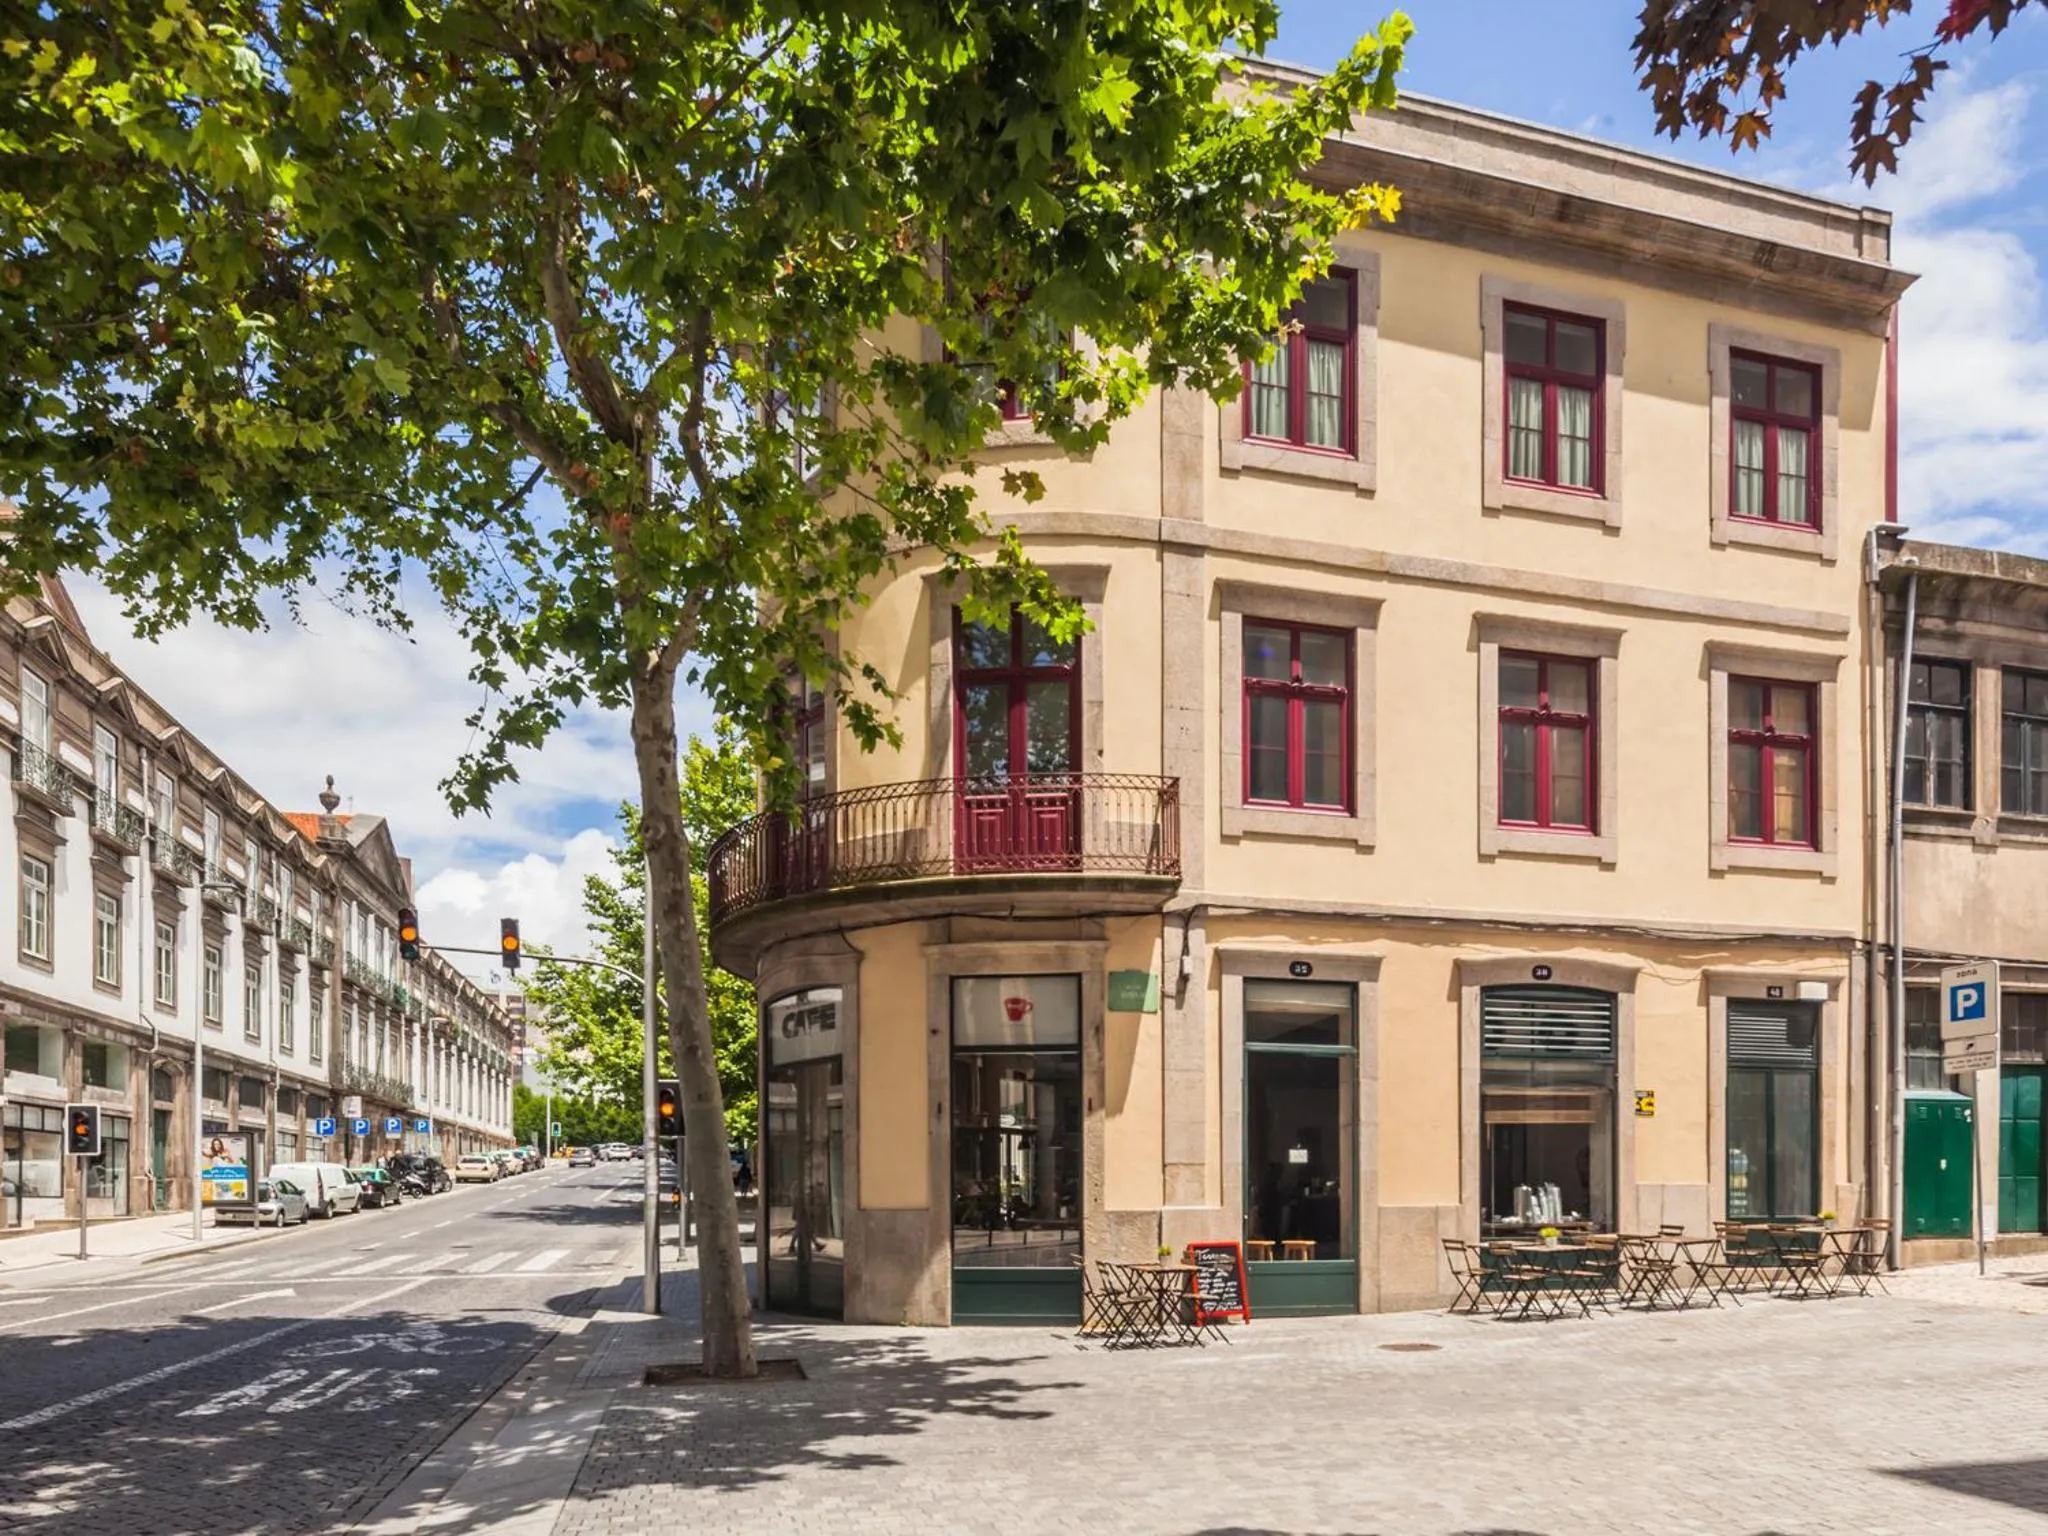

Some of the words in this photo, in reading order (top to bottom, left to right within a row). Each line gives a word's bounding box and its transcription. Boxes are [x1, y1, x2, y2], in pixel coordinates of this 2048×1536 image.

[1957, 988, 1978, 1018] P
[320, 1121, 331, 1134] P
[355, 1120, 366, 1133] P
[388, 1119, 398, 1131] P
[417, 1120, 427, 1131] P
